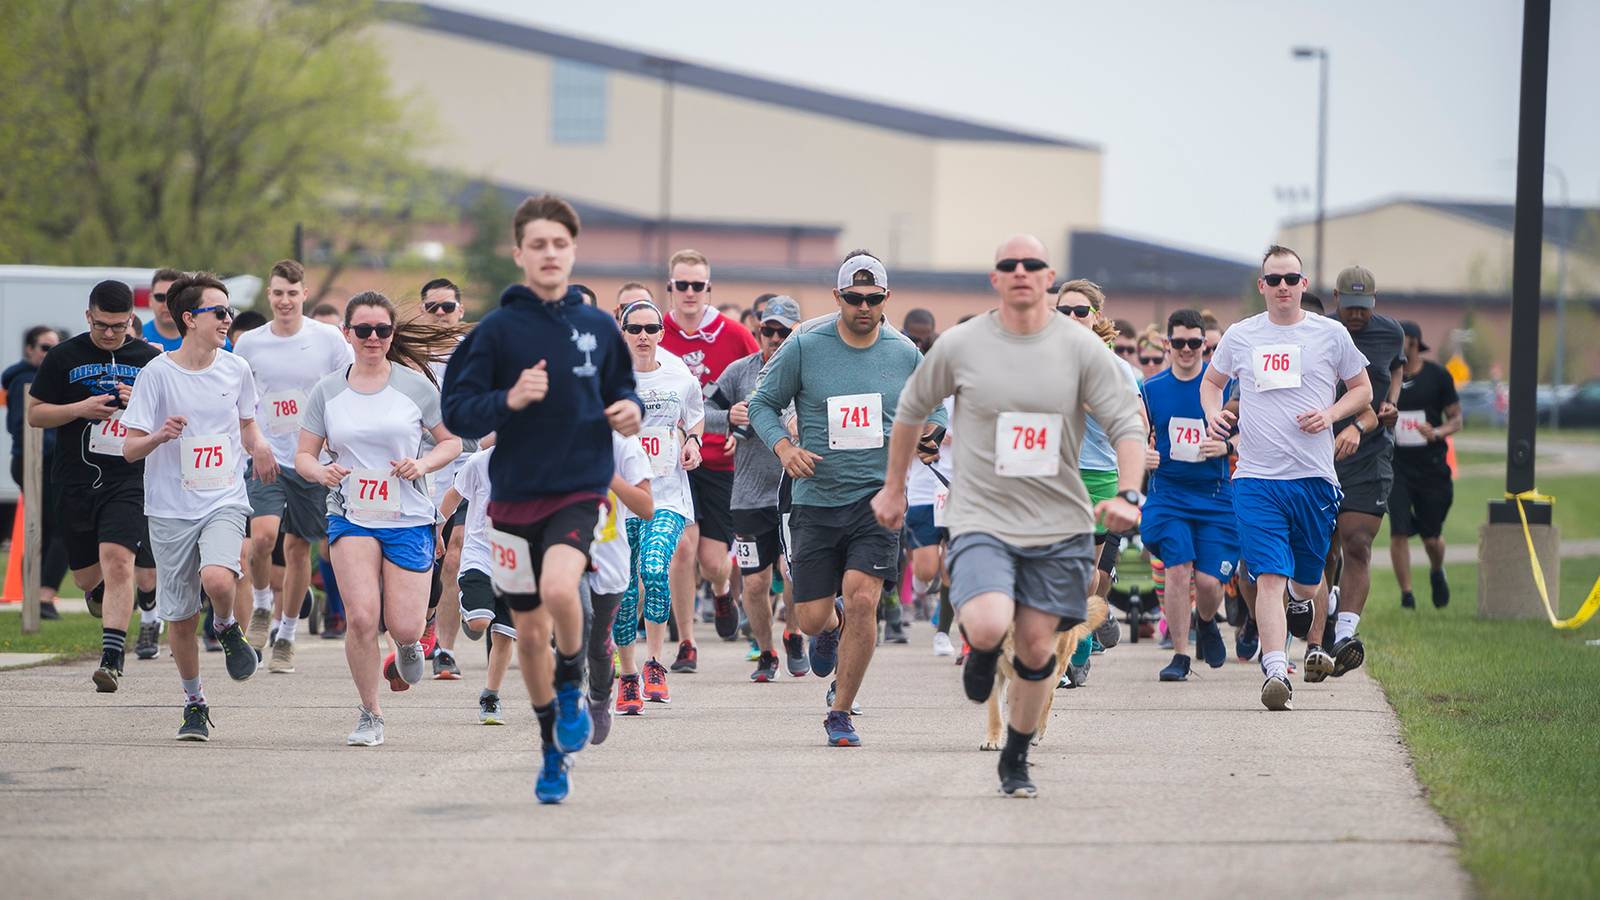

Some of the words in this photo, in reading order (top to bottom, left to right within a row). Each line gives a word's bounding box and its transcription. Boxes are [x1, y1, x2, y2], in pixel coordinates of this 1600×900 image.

[1262, 353, 1290, 372] 766
[272, 399, 298, 417] 788
[840, 406, 870, 428] 741
[1012, 426, 1047, 450] 784
[1176, 426, 1200, 444] 743
[193, 446, 223, 469] 775
[641, 437, 660, 456] 50
[359, 479, 388, 501] 774
[490, 541, 516, 571] 739
